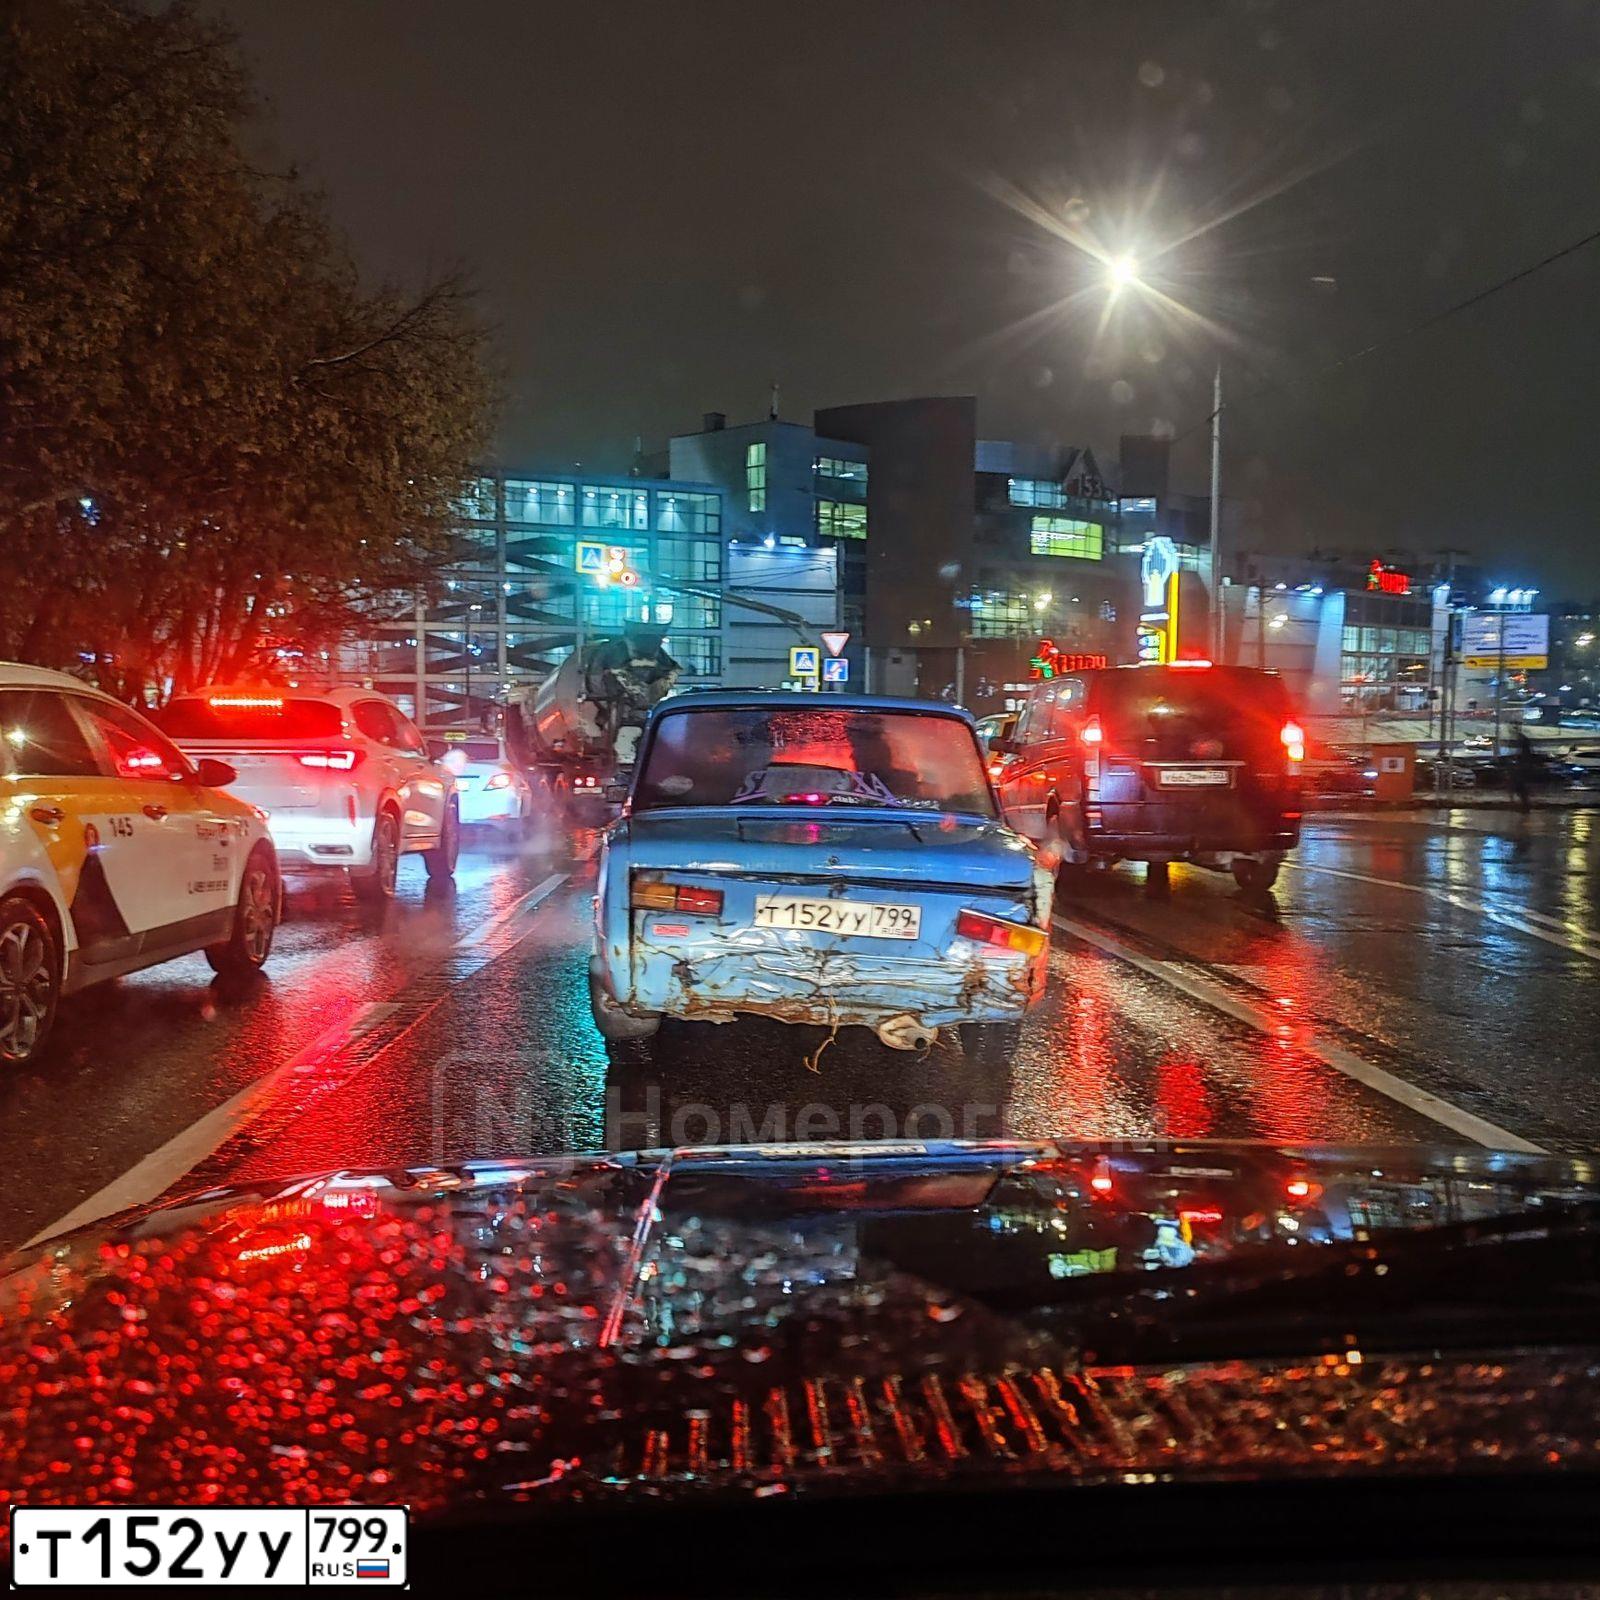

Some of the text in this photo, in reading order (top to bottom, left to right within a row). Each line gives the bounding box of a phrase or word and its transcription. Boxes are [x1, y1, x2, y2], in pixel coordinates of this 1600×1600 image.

[109, 816, 134, 837] 145
[764, 903, 912, 932] Т152УУ 799
[882, 928, 901, 936] RUS
